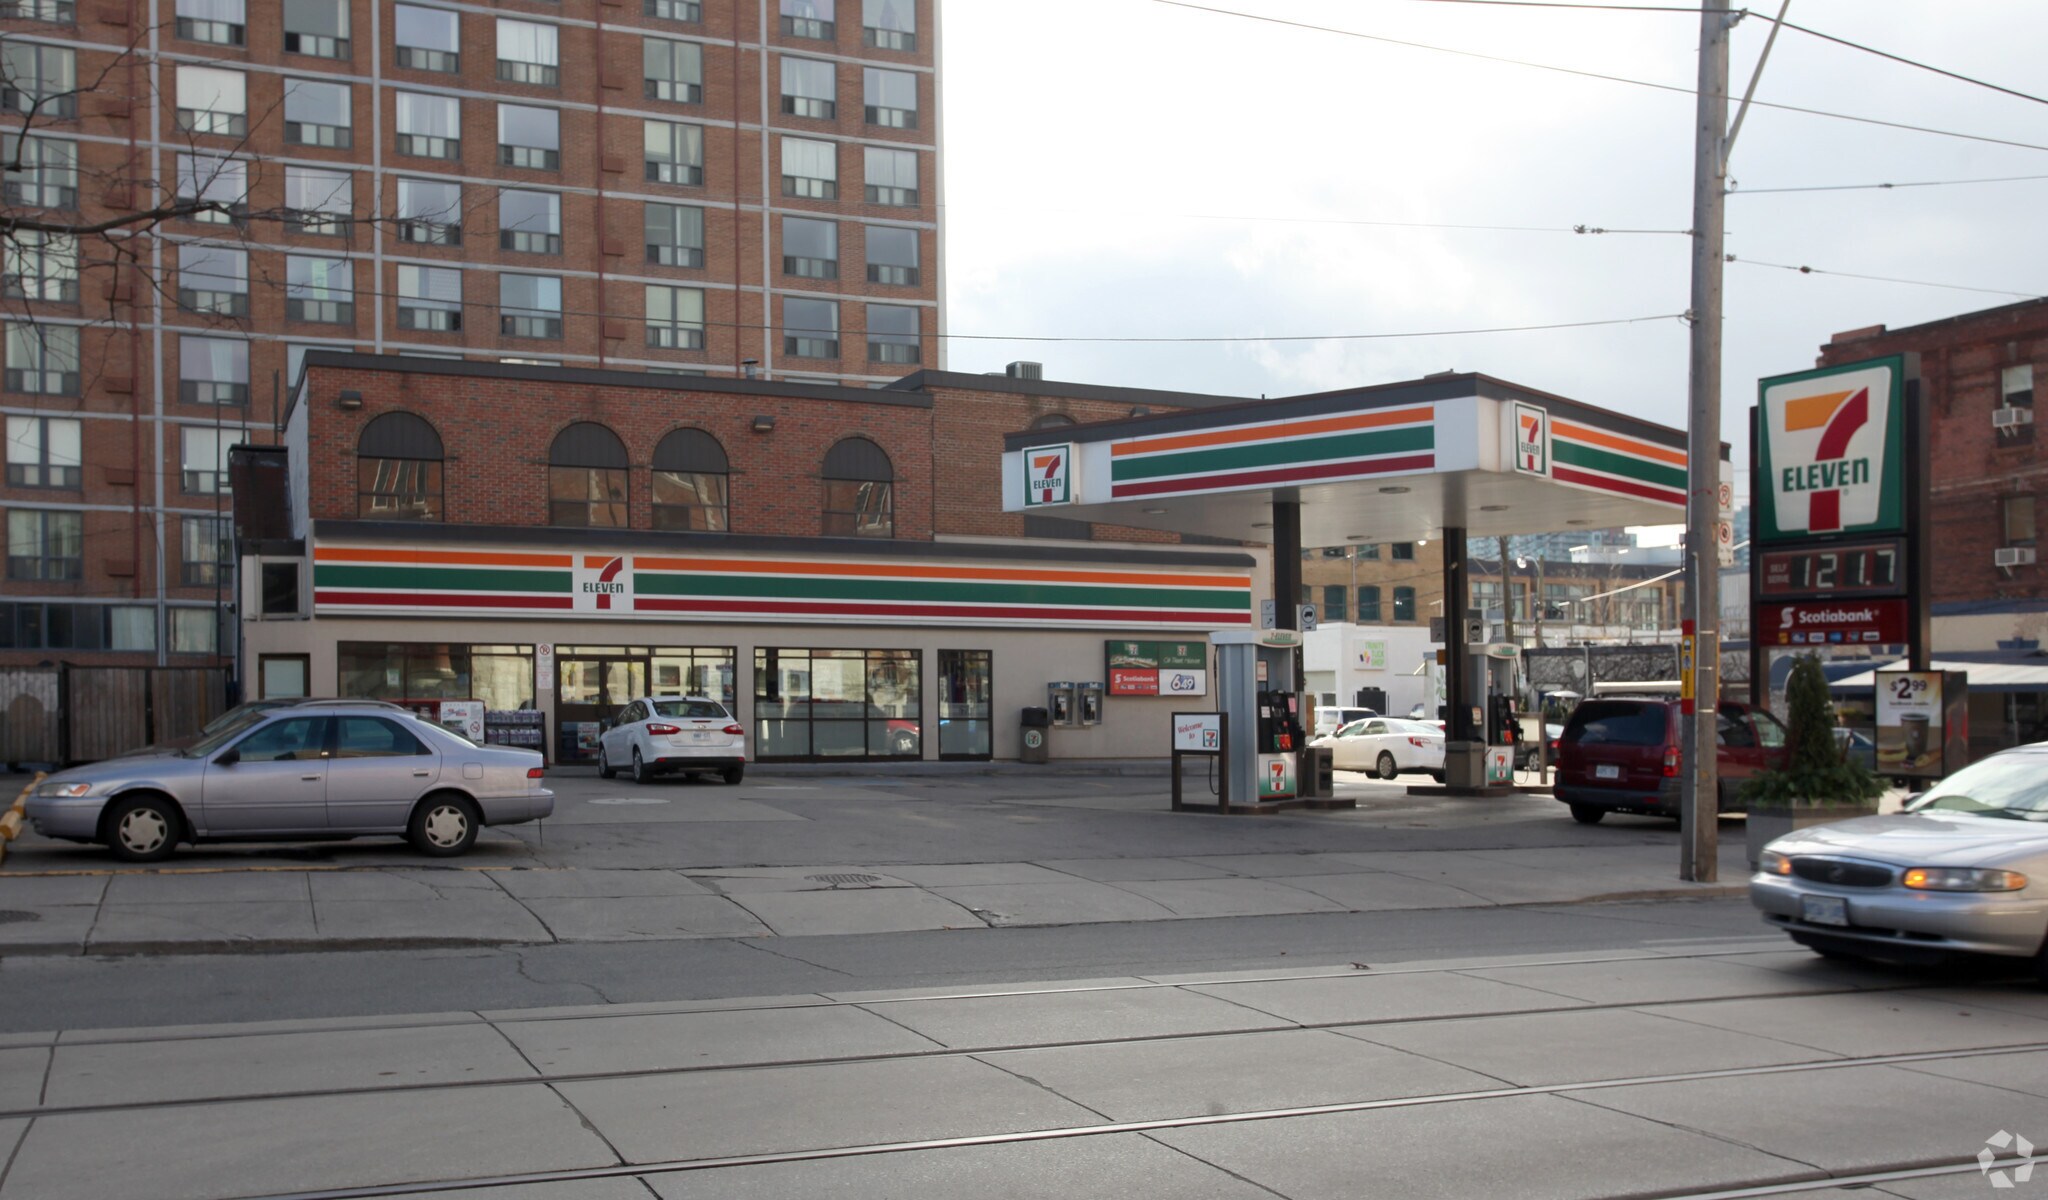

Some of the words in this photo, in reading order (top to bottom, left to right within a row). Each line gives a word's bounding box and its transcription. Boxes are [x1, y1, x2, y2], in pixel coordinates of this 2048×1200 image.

[1521, 442, 1540, 456] ELEVEN
[1783, 457, 1869, 492] ELEVEN
[1033, 478, 1062, 489] ELEVEN
[1769, 563, 1788, 573] SELF
[1767, 574, 1790, 584] SERVE
[583, 582, 624, 593] ELEVEN
[1799, 608, 1873, 624] Scotiabank
[1177, 722, 1204, 733] Welcome
